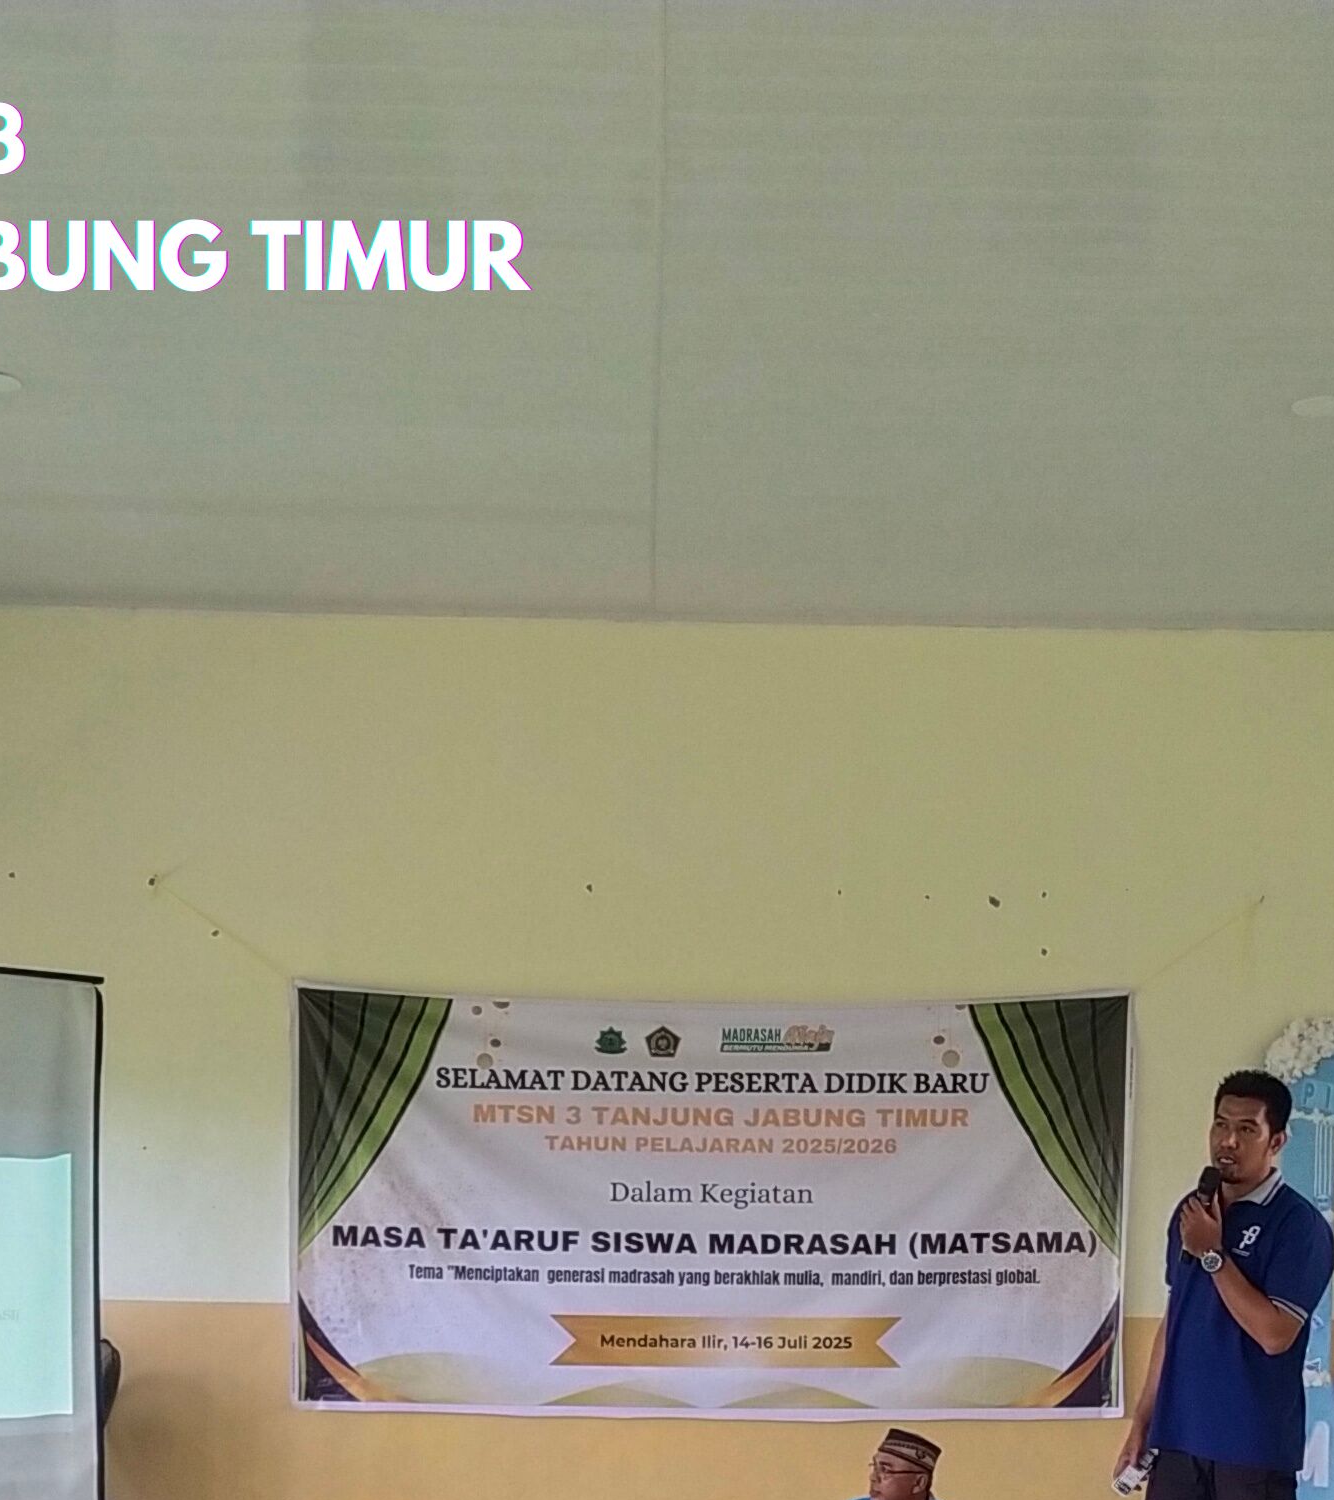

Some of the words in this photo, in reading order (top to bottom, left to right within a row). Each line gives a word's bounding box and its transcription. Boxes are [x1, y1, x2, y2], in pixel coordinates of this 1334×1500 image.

[722, 1028, 782, 1042] MADRASAH
[436, 1066, 565, 1091] SELAMAT
[571, 1069, 689, 1093] DATANG
[694, 1071, 819, 1094] PESERTA
[824, 1071, 908, 1094] DIDIK
[913, 1072, 990, 1094] BARU
[472, 1104, 556, 1125] MTSN
[565, 1106, 582, 1125] 3
[591, 1106, 734, 1127] TANJUNG
[743, 1107, 866, 1128] JABUNG
[875, 1107, 969, 1127] TIMUR
[544, 1135, 627, 1152] TAHUN
[634, 1137, 774, 1153] PELAJARAN
[781, 1138, 898, 1154] 2025/2026
[610, 1182, 693, 1203] Dalam
[699, 1183, 814, 1209] Kegiatan
[332, 1225, 426, 1249] MASA
[437, 1228, 580, 1251] TA'ARUF
[590, 1231, 698, 1254] SISWA
[708, 1233, 897, 1255] MADRASAH
[908, 1231, 1098, 1259] (MATSAMA)
[408, 1264, 443, 1280] Tema
[547, 1268, 605, 1287] generasi
[608, 1268, 675, 1284] madrasah
[678, 1271, 710, 1287] yang
[714, 1269, 780, 1285] berakhlak
[783, 1269, 824, 1287] mulia,
[831, 1269, 886, 1287] mandiri,
[889, 1269, 914, 1286] dan
[917, 1269, 992, 1287] berprestasi
[600, 1333, 697, 1350] Mendahara
[701, 1335, 728, 1352] Ilir,
[732, 1335, 774, 1350] 14-16
[777, 1335, 808, 1350] Juli
[812, 1336, 853, 1350] 2025
